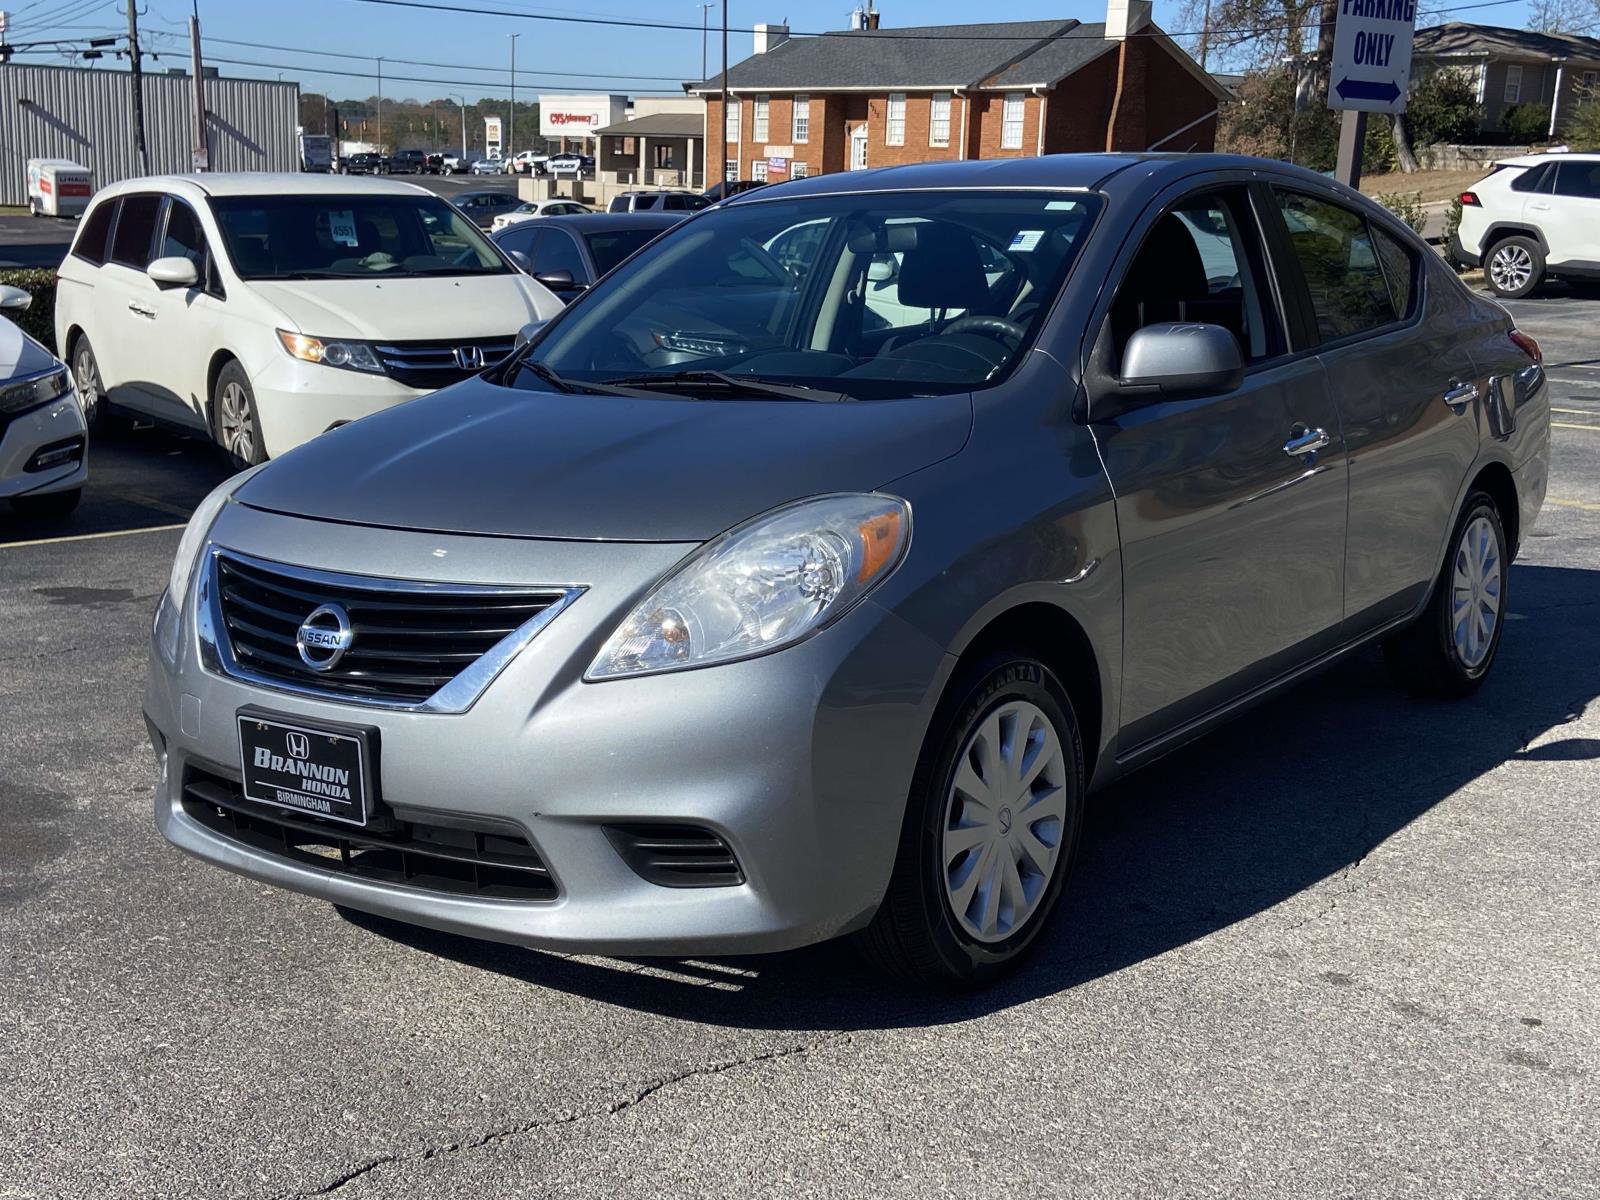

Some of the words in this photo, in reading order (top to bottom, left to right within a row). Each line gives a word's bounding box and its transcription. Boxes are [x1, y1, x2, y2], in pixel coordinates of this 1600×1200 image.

[1353, 30, 1395, 66] ONLY
[300, 630, 340, 645] NISSAN
[301, 778, 351, 800] HONDA
[276, 790, 331, 813] BIRMINGHAM
